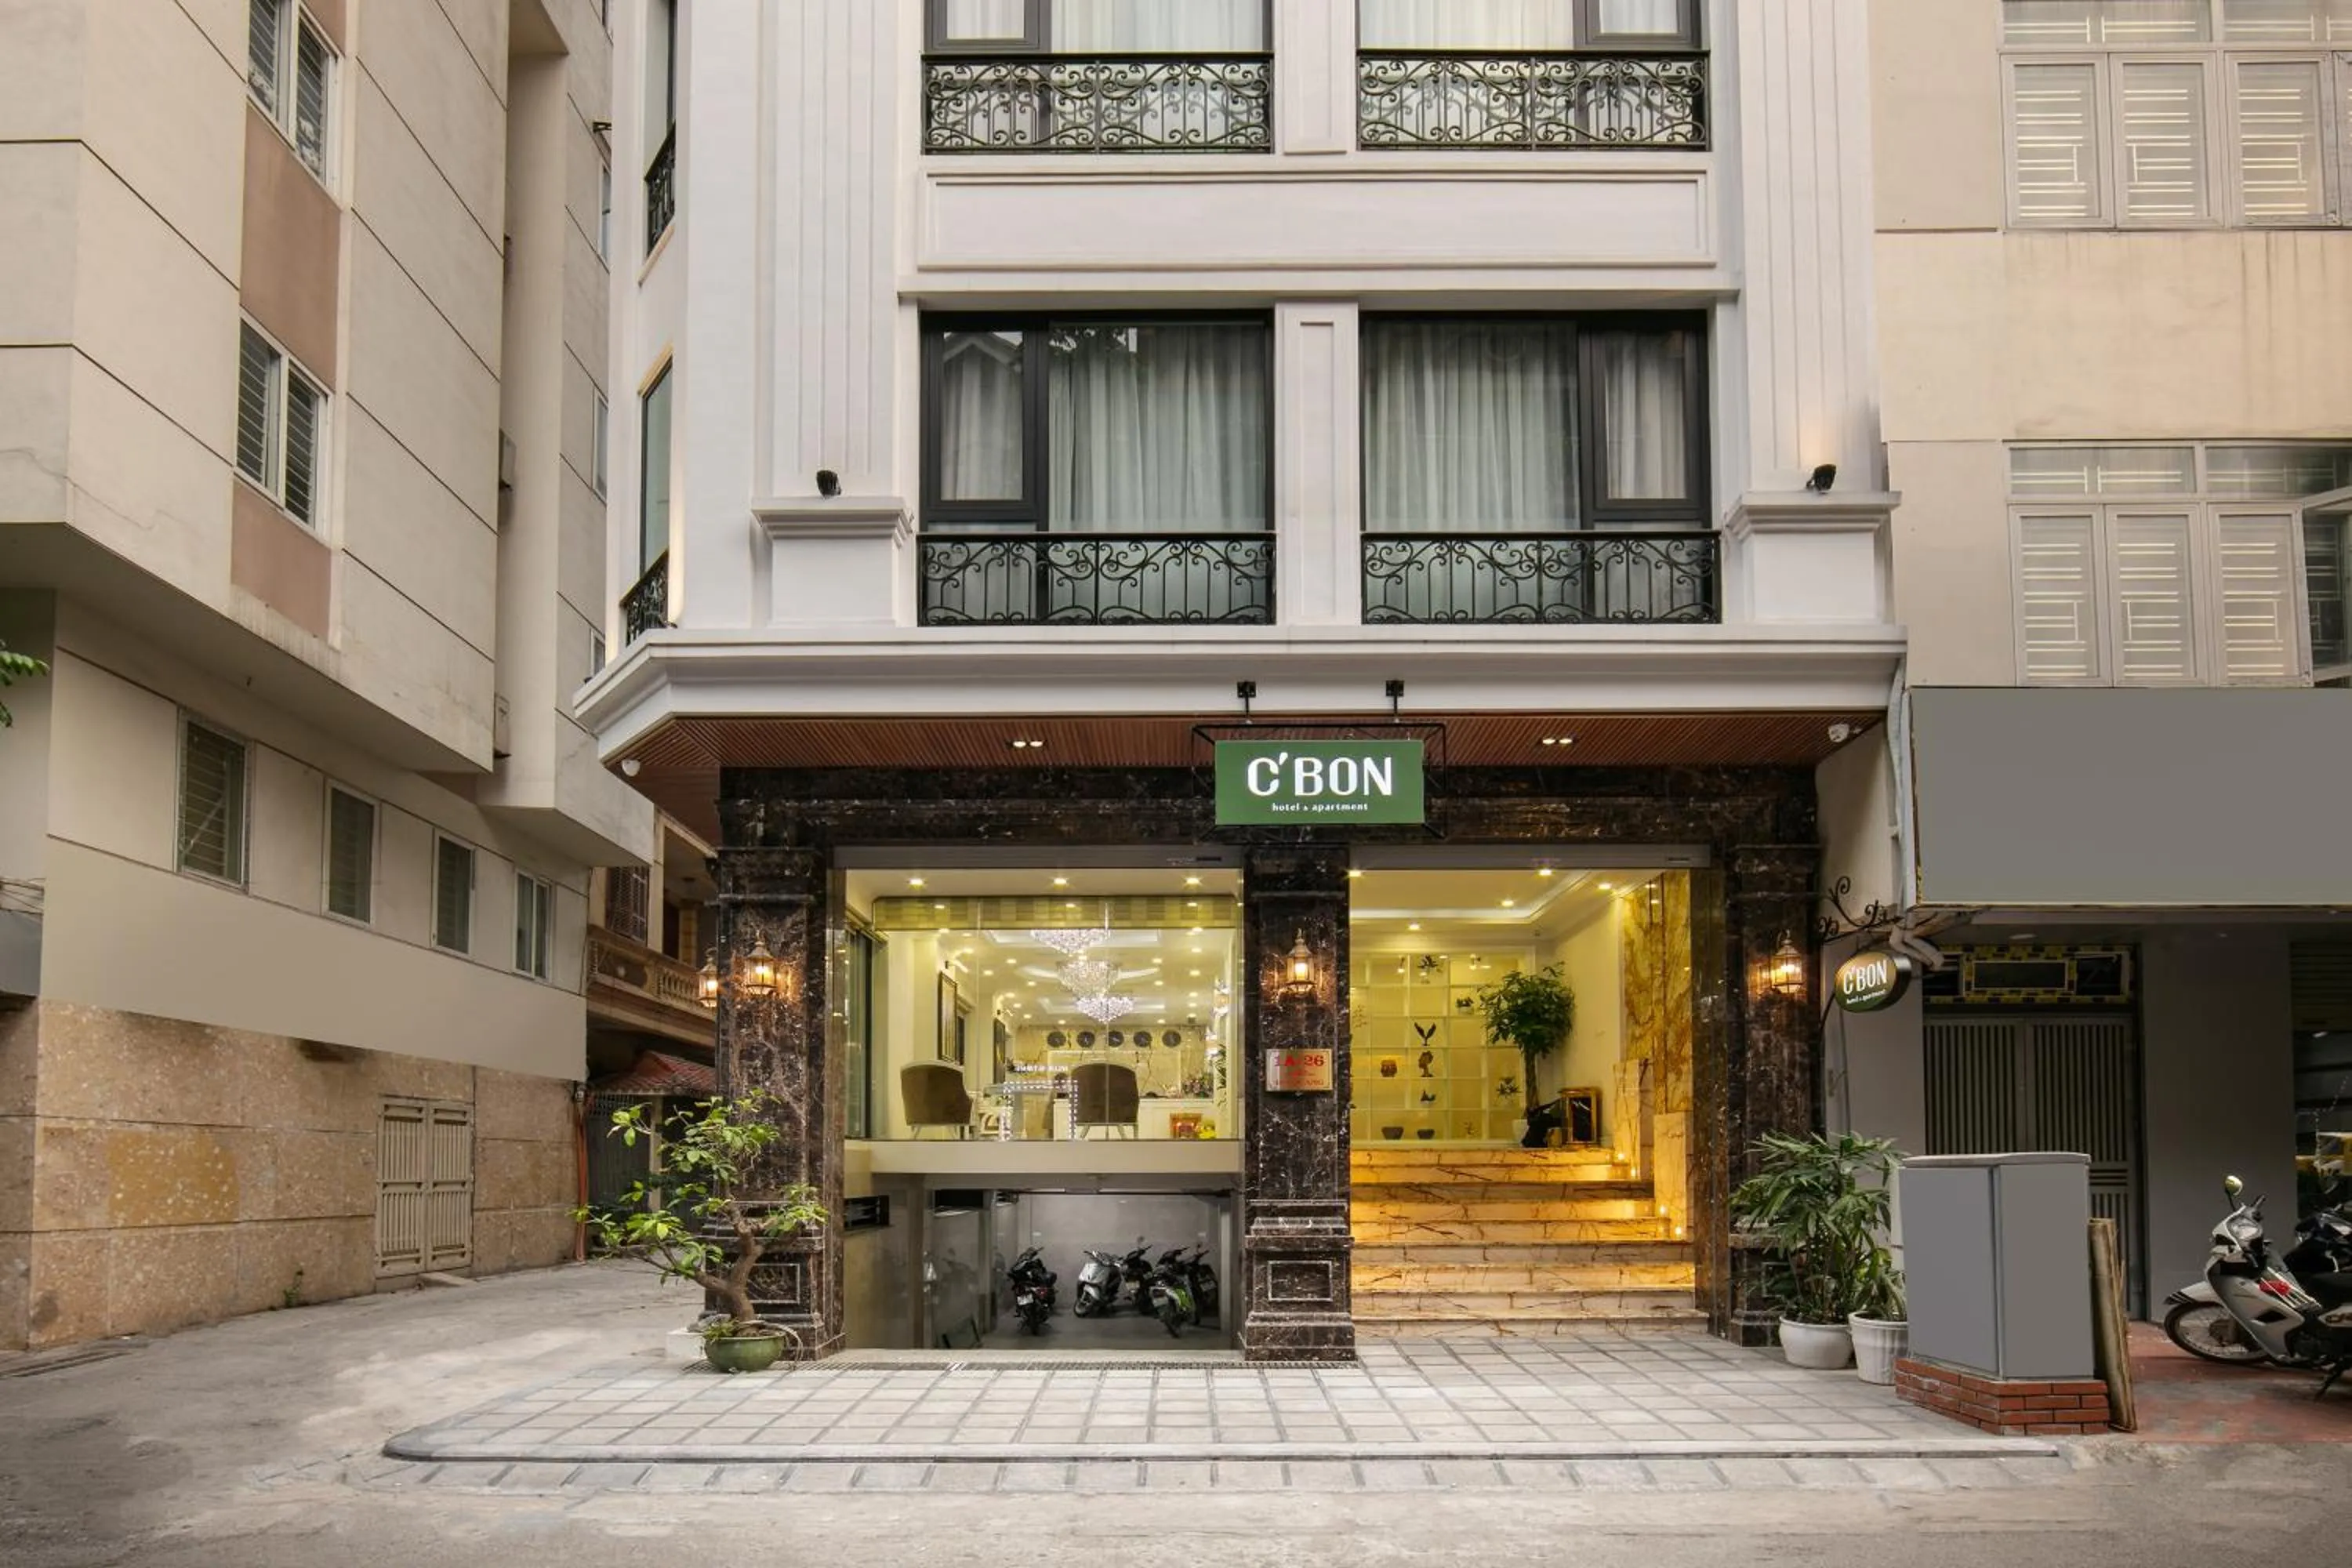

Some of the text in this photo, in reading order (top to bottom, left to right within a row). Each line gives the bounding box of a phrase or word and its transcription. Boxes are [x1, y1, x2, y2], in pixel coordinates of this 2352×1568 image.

[1247, 752, 1392, 797] C'BON
[1272, 803, 1300, 811] hotel
[1312, 803, 1368, 813] apartment
[1843, 959, 1887, 995] C'BON
